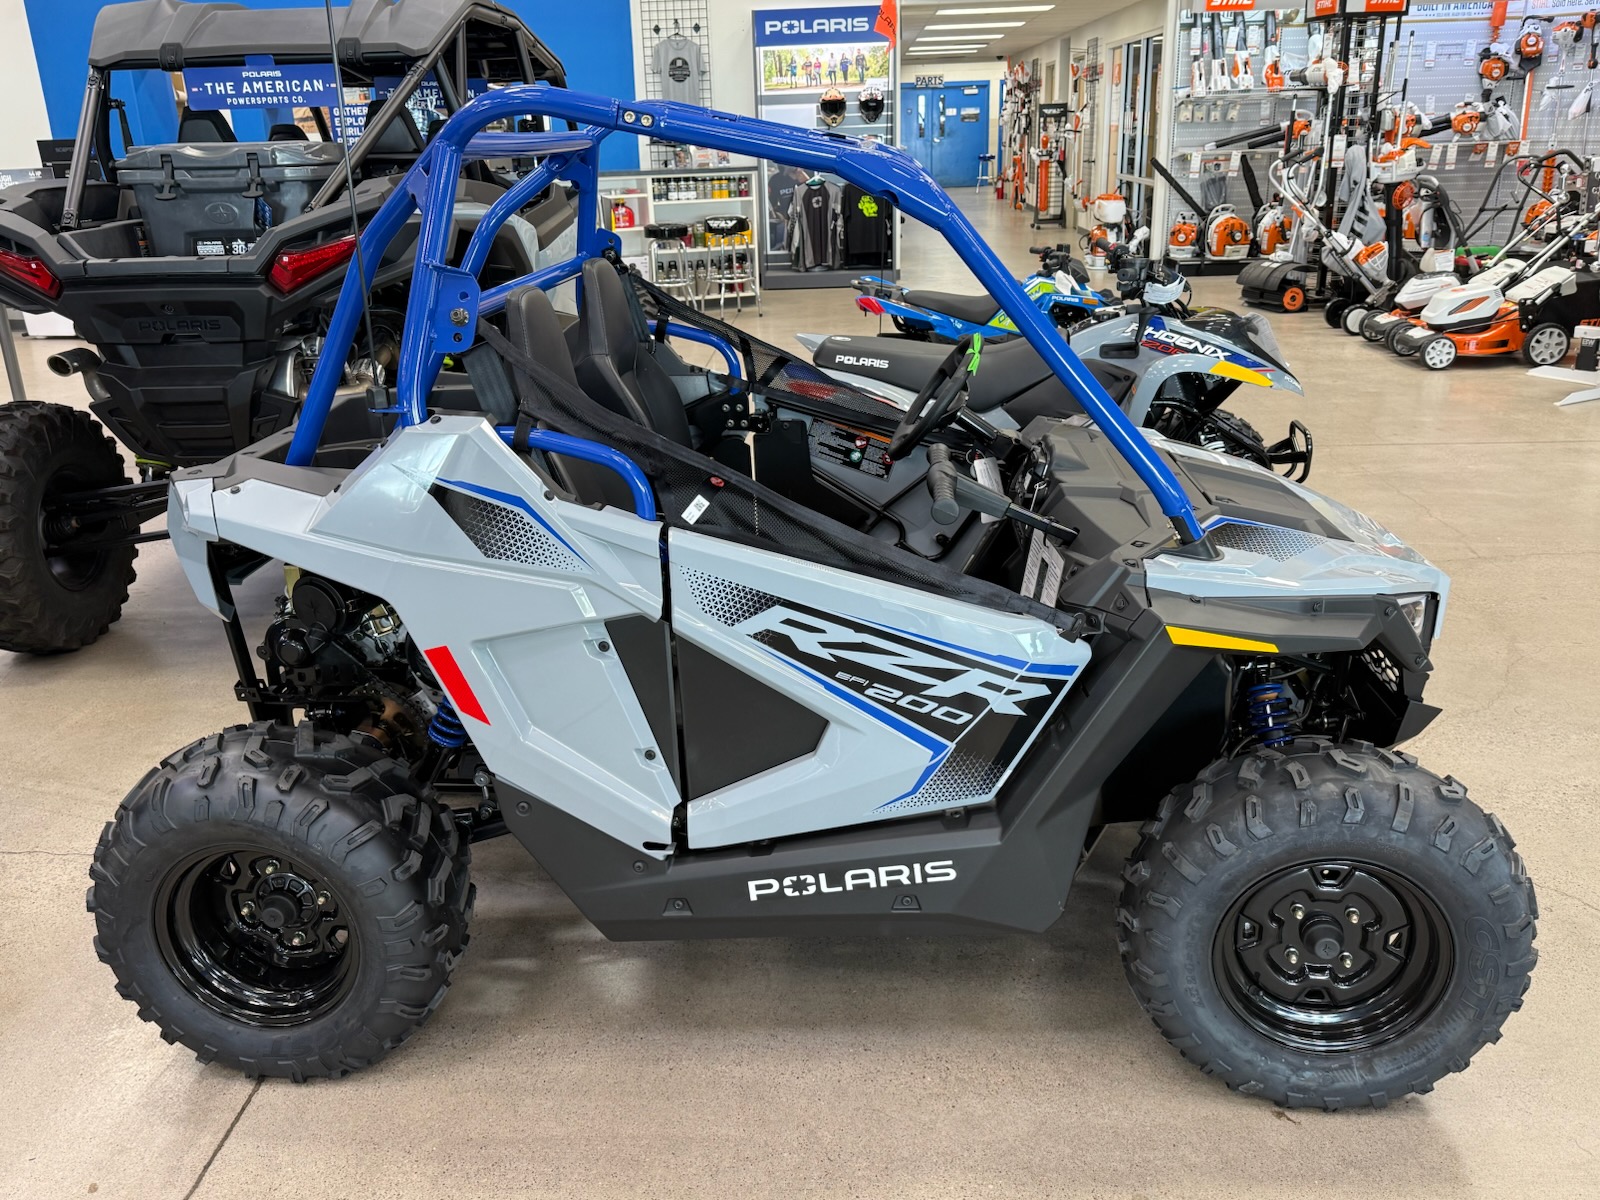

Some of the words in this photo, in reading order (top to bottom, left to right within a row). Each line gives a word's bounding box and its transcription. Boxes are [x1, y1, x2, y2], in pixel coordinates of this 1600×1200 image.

[764, 17, 869, 35] POLARIS
[204, 82, 236, 95] THE
[242, 79, 324, 94] AMERICAN
[916, 76, 943, 85] PARTS
[227, 96, 289, 105] POWERSPORTS
[1051, 295, 1079, 303] POLARIS
[138, 319, 222, 332] POLARIS
[1124, 322, 1231, 361] PHOENIX
[835, 354, 889, 369] POLARIS
[743, 604, 1052, 717] RZR
[834, 671, 869, 687] EFI
[864, 683, 974, 725] 200
[747, 860, 957, 902] POLARIS
